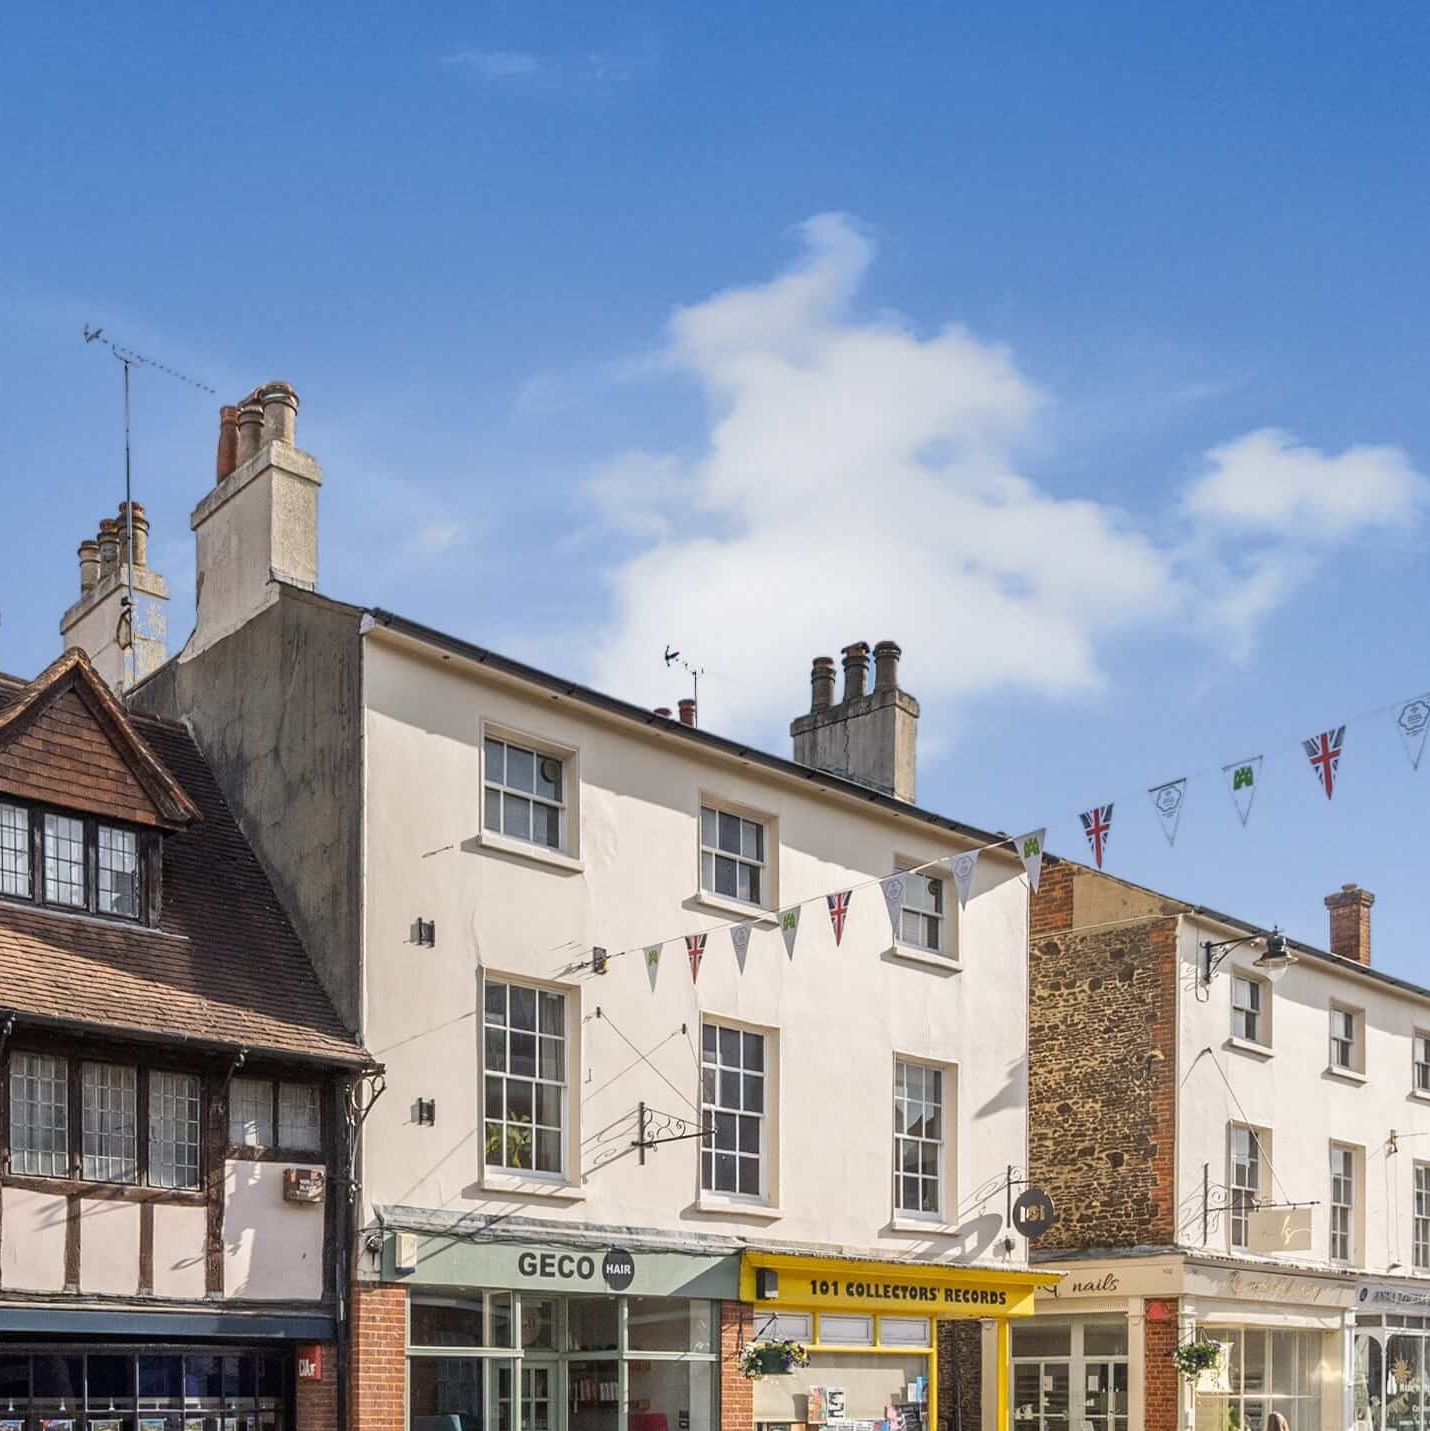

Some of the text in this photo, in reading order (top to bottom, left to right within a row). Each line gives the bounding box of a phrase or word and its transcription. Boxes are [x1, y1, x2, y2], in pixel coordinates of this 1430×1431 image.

[518, 1252, 595, 1280] GECO
[606, 1264, 632, 1275] HAIR
[810, 1280, 1007, 1305] 101 COLLECTORS' RECORDS
[1072, 1272, 1120, 1292] nails
